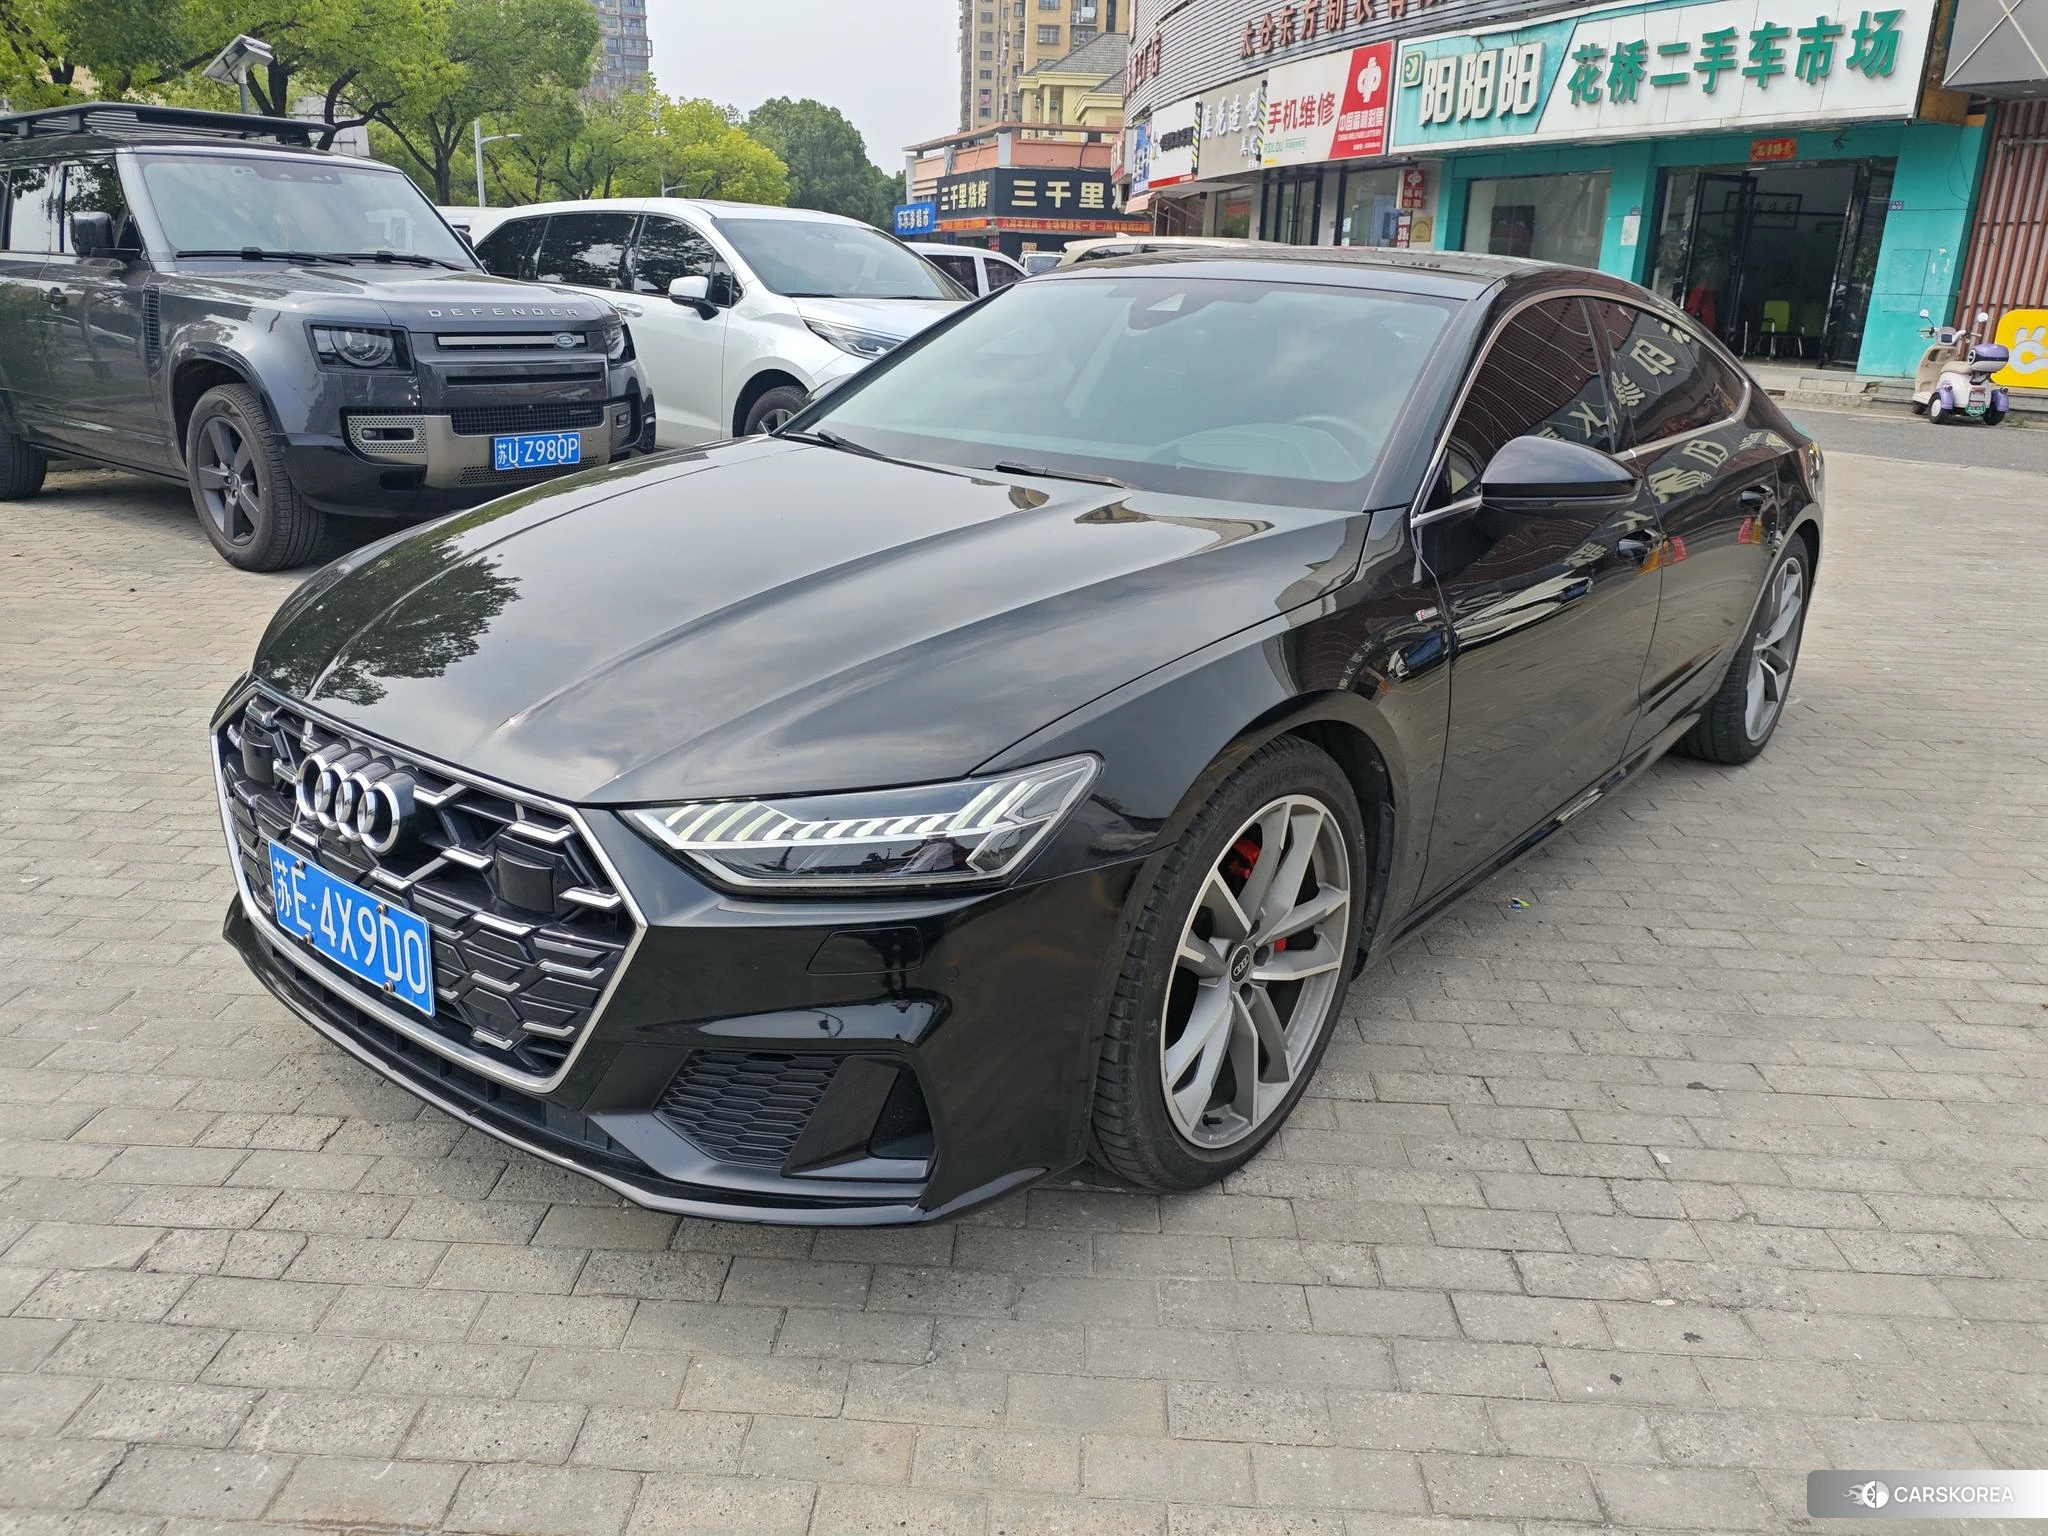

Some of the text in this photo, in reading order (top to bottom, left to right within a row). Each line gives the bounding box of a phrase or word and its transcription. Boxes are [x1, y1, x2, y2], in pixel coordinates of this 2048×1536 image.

[1567, 9, 1905, 105] 花桥二手车市场
[1267, 91, 1336, 134] 手机维修
[1338, 107, 1385, 131] 中国福利彩票
[940, 180, 988, 211] 三千里烧烤
[1011, 180, 1121, 211] 三千里
[428, 308, 580, 317] DEFENDER
